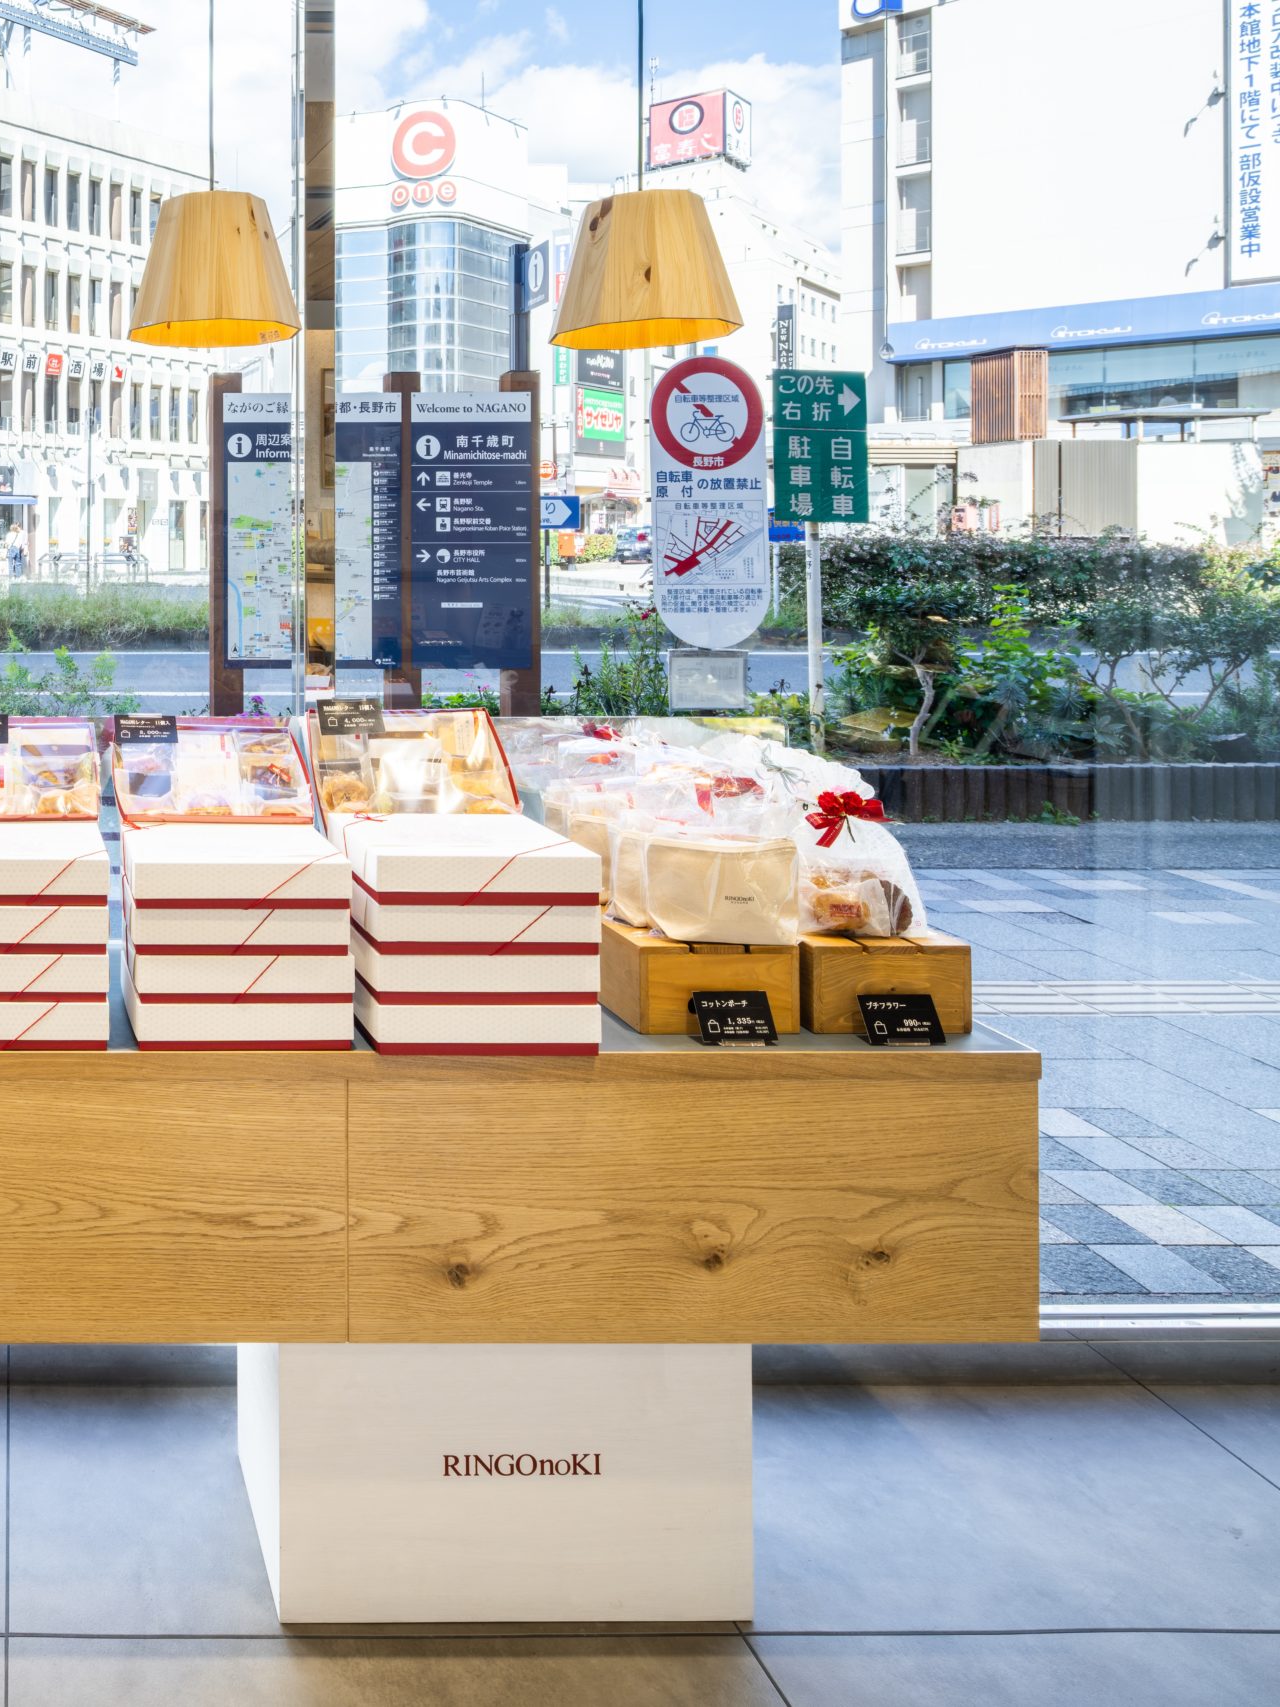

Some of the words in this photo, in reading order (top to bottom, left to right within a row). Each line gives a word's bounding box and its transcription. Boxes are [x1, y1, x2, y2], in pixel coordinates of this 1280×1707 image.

[1239, 2, 1261, 258] 本館地下1階にて一部仮設営業中
[393, 182, 456, 204] one
[778, 320, 789, 341] NEW
[70, 360, 104, 377] 酒場
[778, 375, 835, 395] この先
[674, 394, 740, 403] 自転車等整理区域
[226, 401, 289, 414] ながのご縁
[416, 403, 460, 413] Welcome
[463, 404, 473, 413] to
[476, 403, 527, 413] NAGANO
[782, 401, 832, 421] 右折
[585, 408, 622, 431] サイゼリヤ
[456, 435, 515, 448] 南千歳町
[444, 450, 527, 460] Minamichitose-machi
[693, 456, 724, 467] 長野市
[656, 471, 693, 483] 自転車
[787, 435, 814, 517] 駐車場
[830, 436, 855, 517] 自転車
[453, 479, 473, 487] Zenkoji
[474, 479, 493, 487] Temple
[697, 478, 762, 490] の放置禁止
[675, 502, 744, 510] 自転車等整理区域
[701, 999, 748, 1008] コットンポーチ
[865, 1001, 907, 1010] プチフラワー
[443, 1453, 601, 1476] RINGOnoKI
